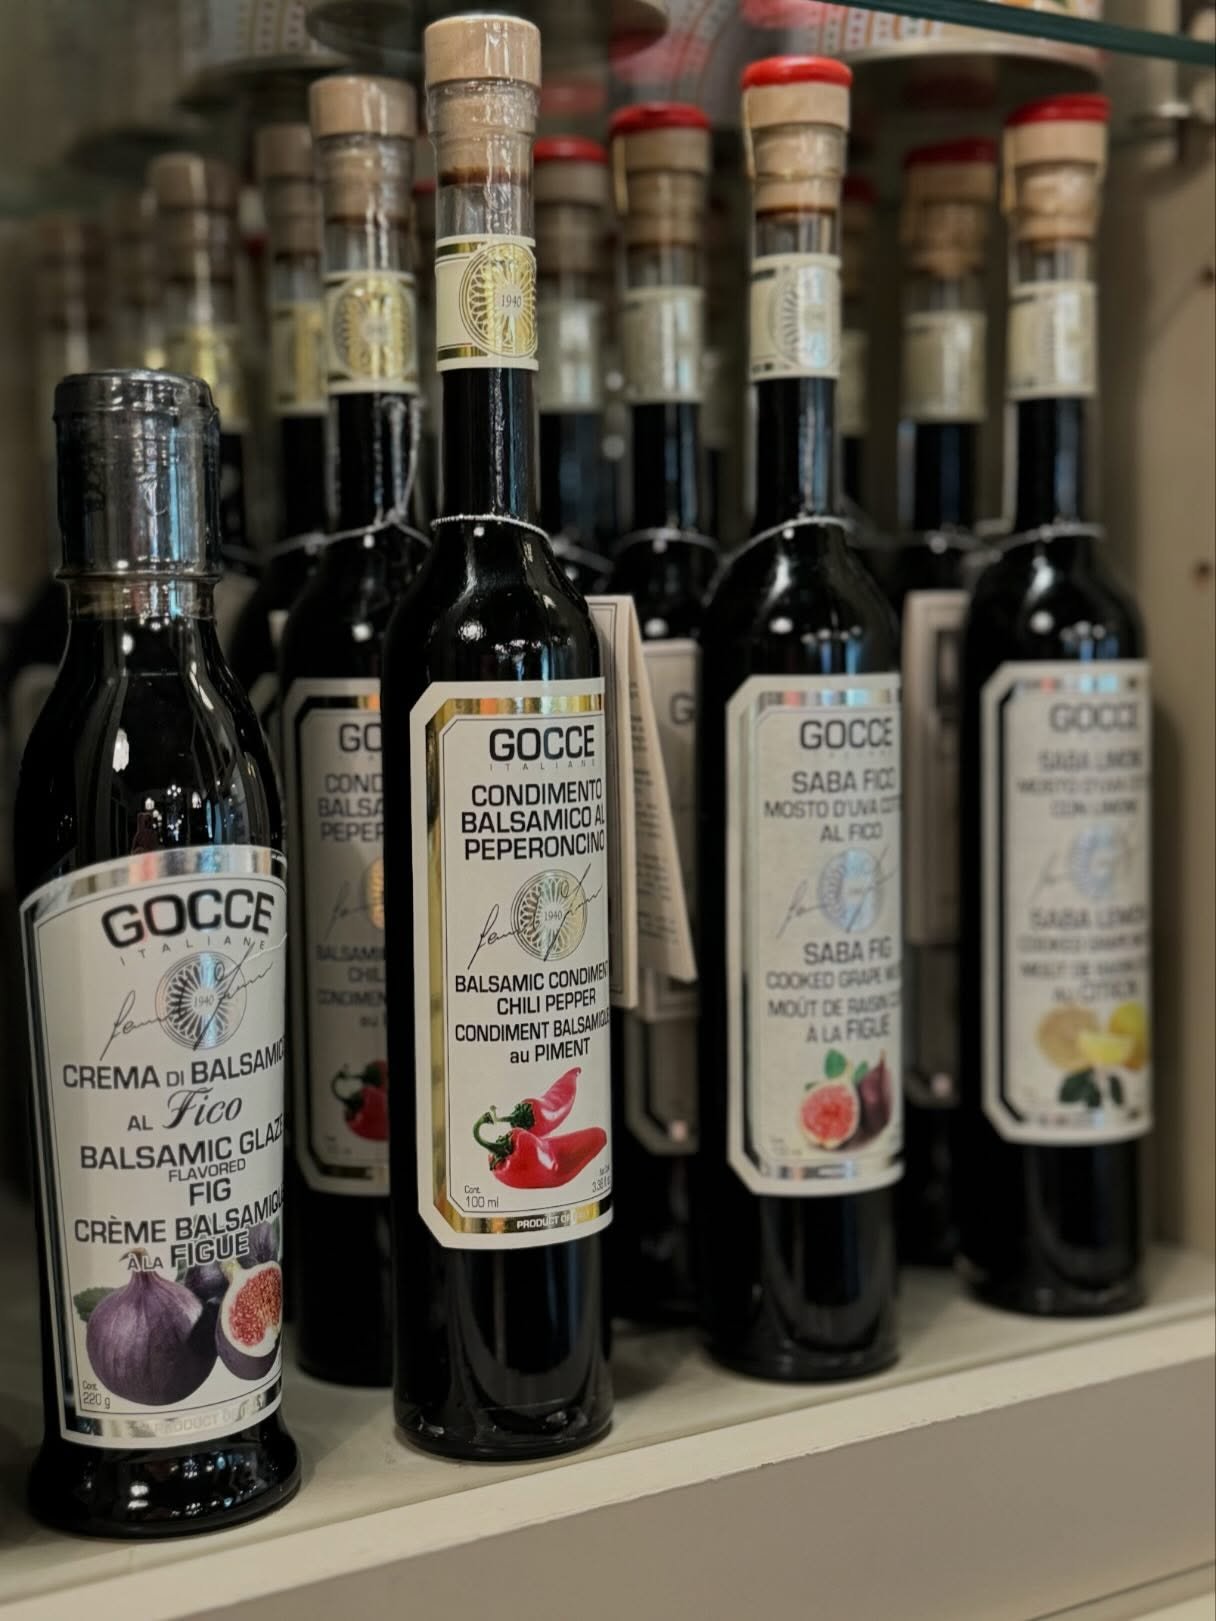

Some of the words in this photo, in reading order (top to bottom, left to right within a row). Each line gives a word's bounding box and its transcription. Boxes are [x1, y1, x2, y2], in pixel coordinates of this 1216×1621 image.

[501, 295, 522, 308] 1940
[489, 724, 595, 762] GOCCE
[800, 717, 893, 750] GOCCE
[471, 777, 602, 807] CONDIMENTO
[791, 770, 857, 794] SABA
[461, 806, 592, 834] BALSAMICO
[763, 799, 829, 819] MOSTO
[465, 829, 605, 861] PEPERONCINO
[820, 824, 843, 843] AL
[849, 821, 882, 841] FICO
[101, 888, 275, 948] GOCCE
[544, 910, 563, 921] 1940
[119, 936, 266, 966] ITALIANE
[804, 940, 864, 966] SABA
[455, 972, 545, 993] BALSAMIC
[766, 971, 835, 990] COOKED
[497, 995, 541, 1016] CHILI
[546, 987, 596, 1013] PEPPER
[822, 999, 843, 1017] DE
[455, 1022, 550, 1043] CONDIMENT
[822, 1025, 843, 1043] LA
[510, 1050, 530, 1064] au
[535, 1037, 590, 1062] PIMENT
[63, 1064, 161, 1090] CREMA
[166, 1070, 185, 1087] DI
[127, 1115, 153, 1132] AL
[162, 1086, 243, 1130] Fico
[80, 1136, 232, 1170] BALSAMIC
[169, 1158, 246, 1182] FLAVORED
[189, 1177, 232, 1206] FIG
[466, 1196, 485, 1209] 100
[487, 1196, 499, 1208] ml
[74, 1215, 167, 1244] CRÈME
[516, 1214, 560, 1229] PRODUCT
[144, 1256, 164, 1270] LA
[170, 1231, 249, 1269] FIGUE
[83, 1392, 101, 1406] 220
[103, 1396, 111, 1409] g
